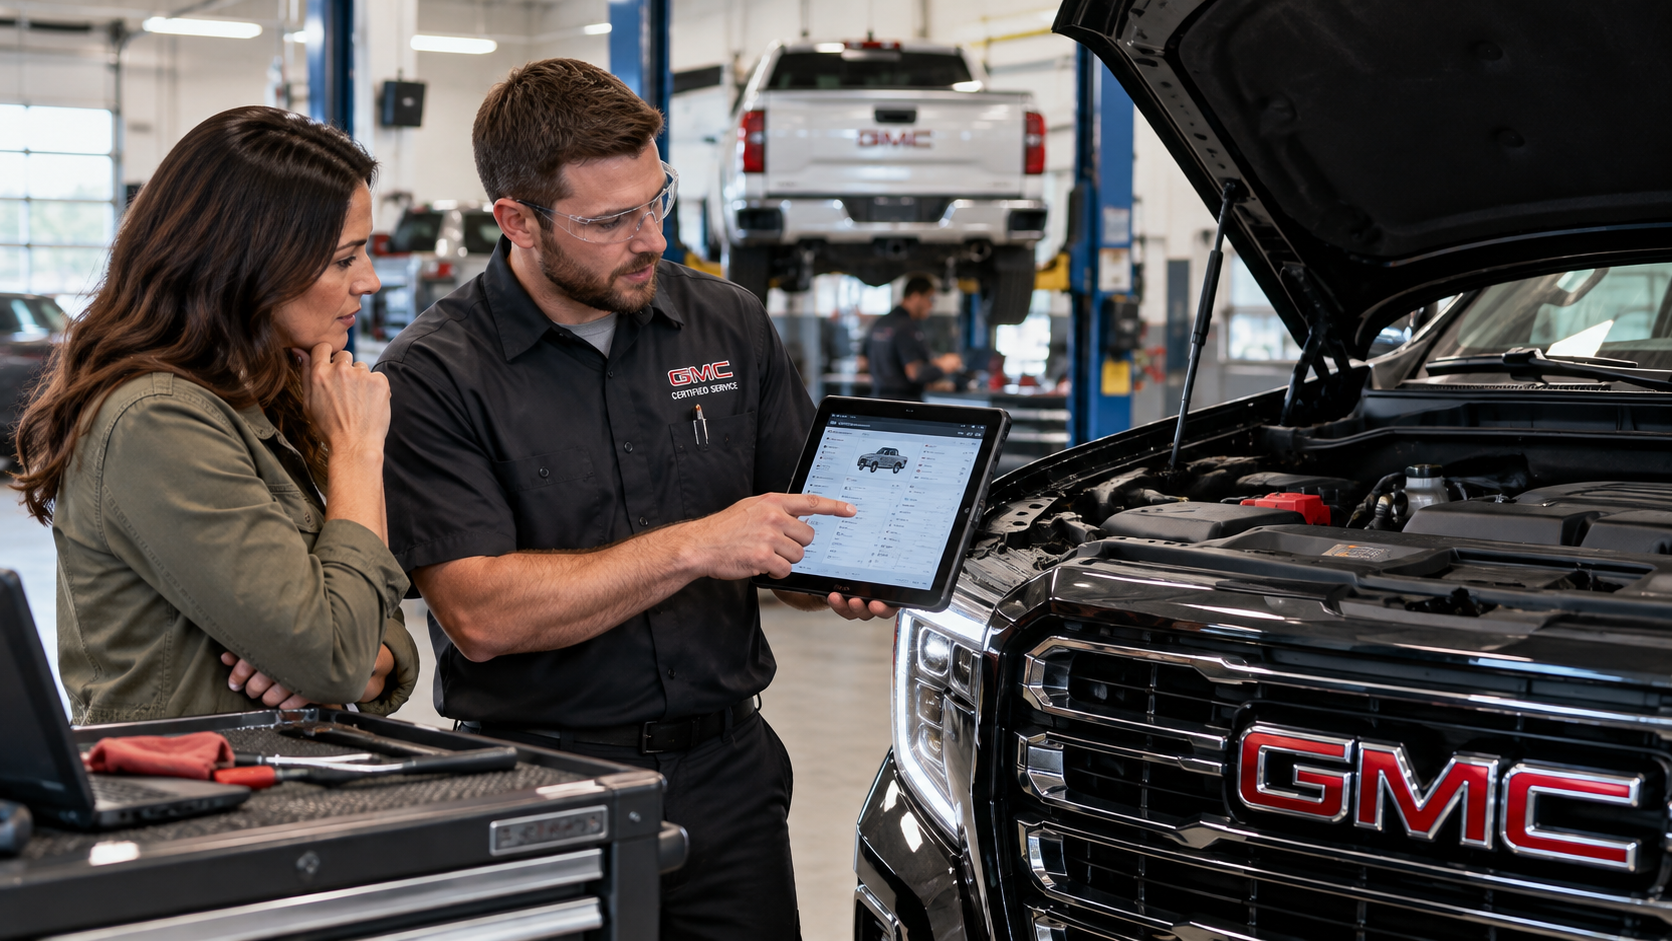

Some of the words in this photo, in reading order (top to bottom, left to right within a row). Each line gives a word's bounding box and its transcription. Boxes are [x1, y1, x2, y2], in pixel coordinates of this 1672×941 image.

[858, 129, 932, 149] GMC
[668, 360, 734, 386] GMC
[710, 381, 738, 393] SERVICE
[1237, 721, 1645, 872] GMC
